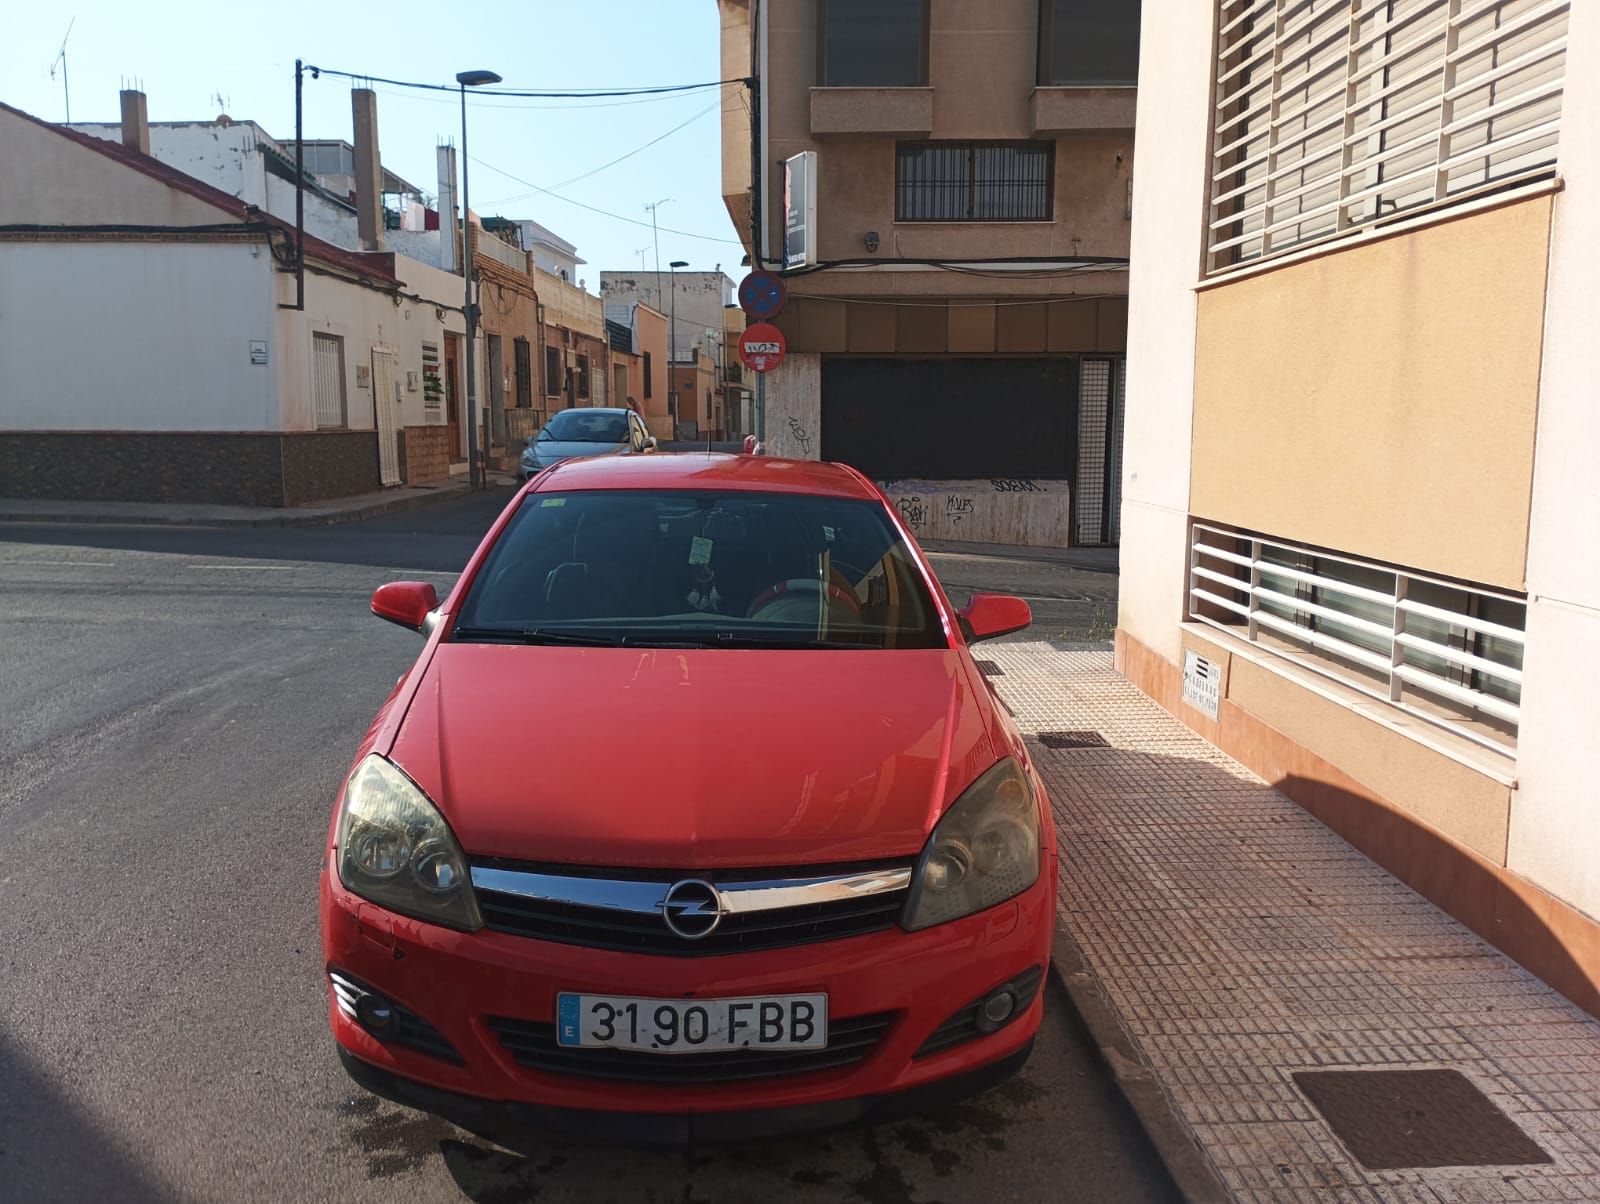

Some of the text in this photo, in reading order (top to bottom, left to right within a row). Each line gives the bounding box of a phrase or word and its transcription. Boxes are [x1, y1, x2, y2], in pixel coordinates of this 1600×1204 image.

[565, 1026, 574, 1037] E
[591, 1001, 815, 1045] 3190 FBB
